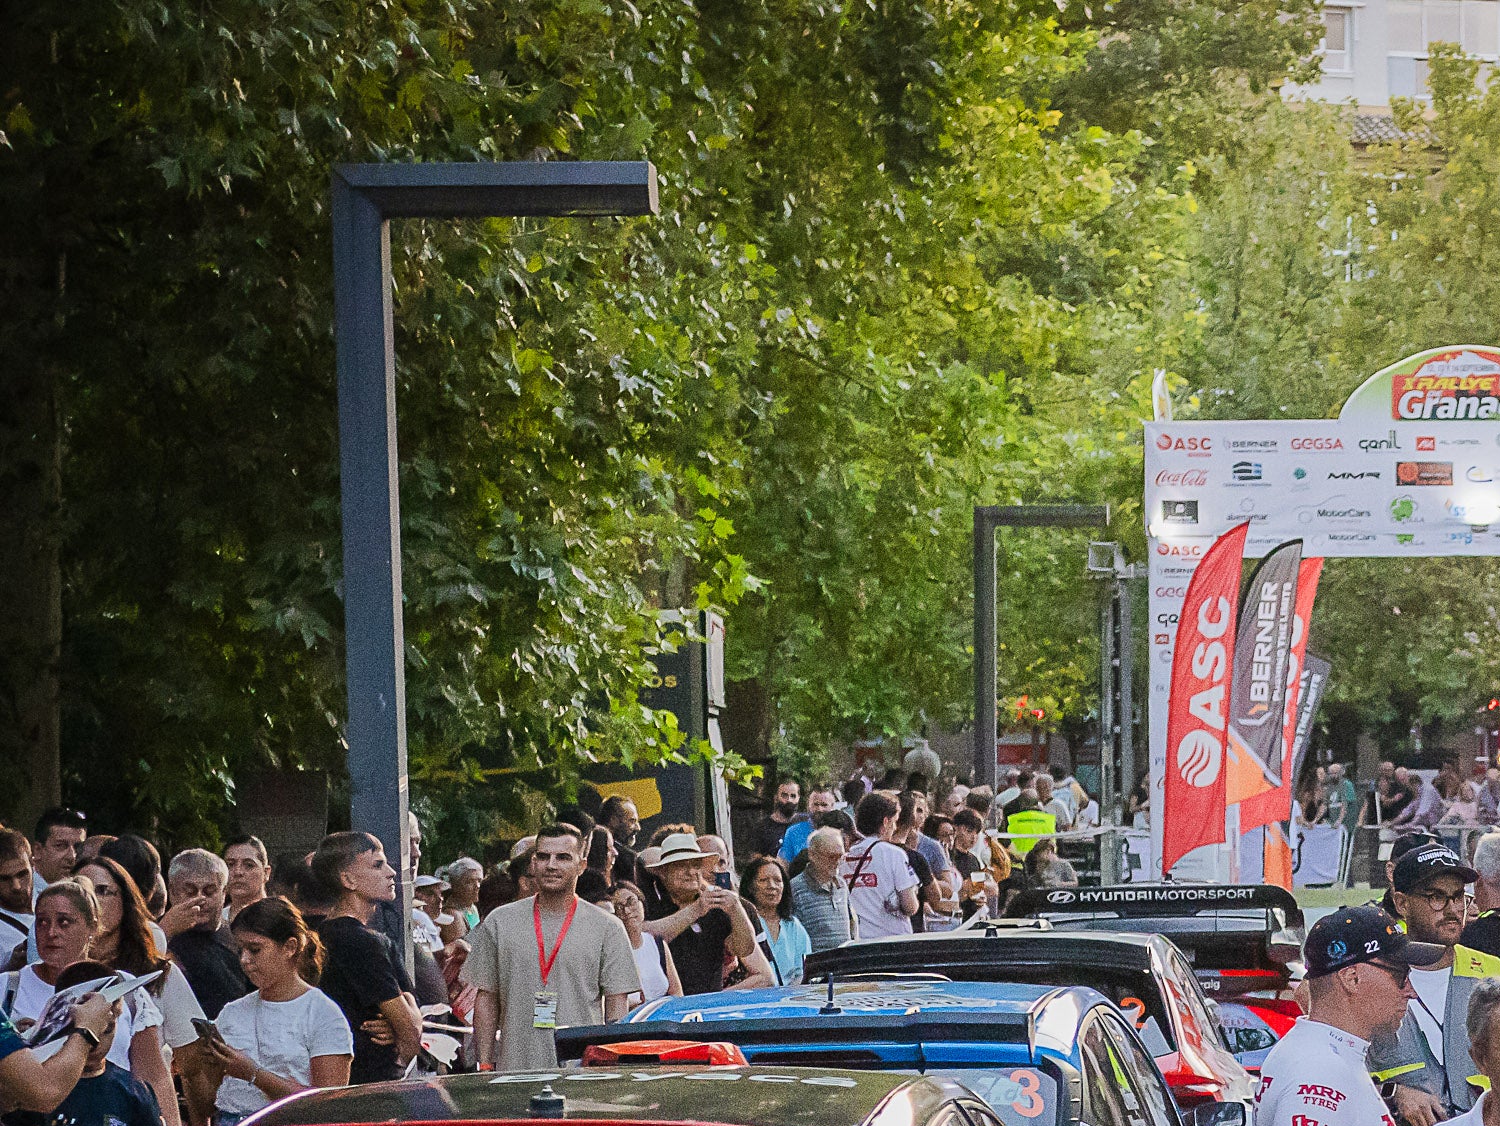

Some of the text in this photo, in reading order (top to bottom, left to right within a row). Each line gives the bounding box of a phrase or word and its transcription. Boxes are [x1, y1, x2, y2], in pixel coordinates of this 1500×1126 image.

[1416, 377, 1497, 390] RALLYE
[1173, 437, 1212, 450] ASC
[1232, 440, 1278, 448] BERNER
[1171, 545, 1201, 556] ASC
[1249, 581, 1280, 701] BERNER
[1189, 595, 1231, 731] ASC
[1079, 888, 1256, 902] HYUNDAI MOTORSPORT
[1363, 939, 1381, 955] 22
[1009, 1069, 1045, 1118] 3
[1296, 1083, 1347, 1104] MRF
[1303, 1096, 1338, 1112] TYRES
